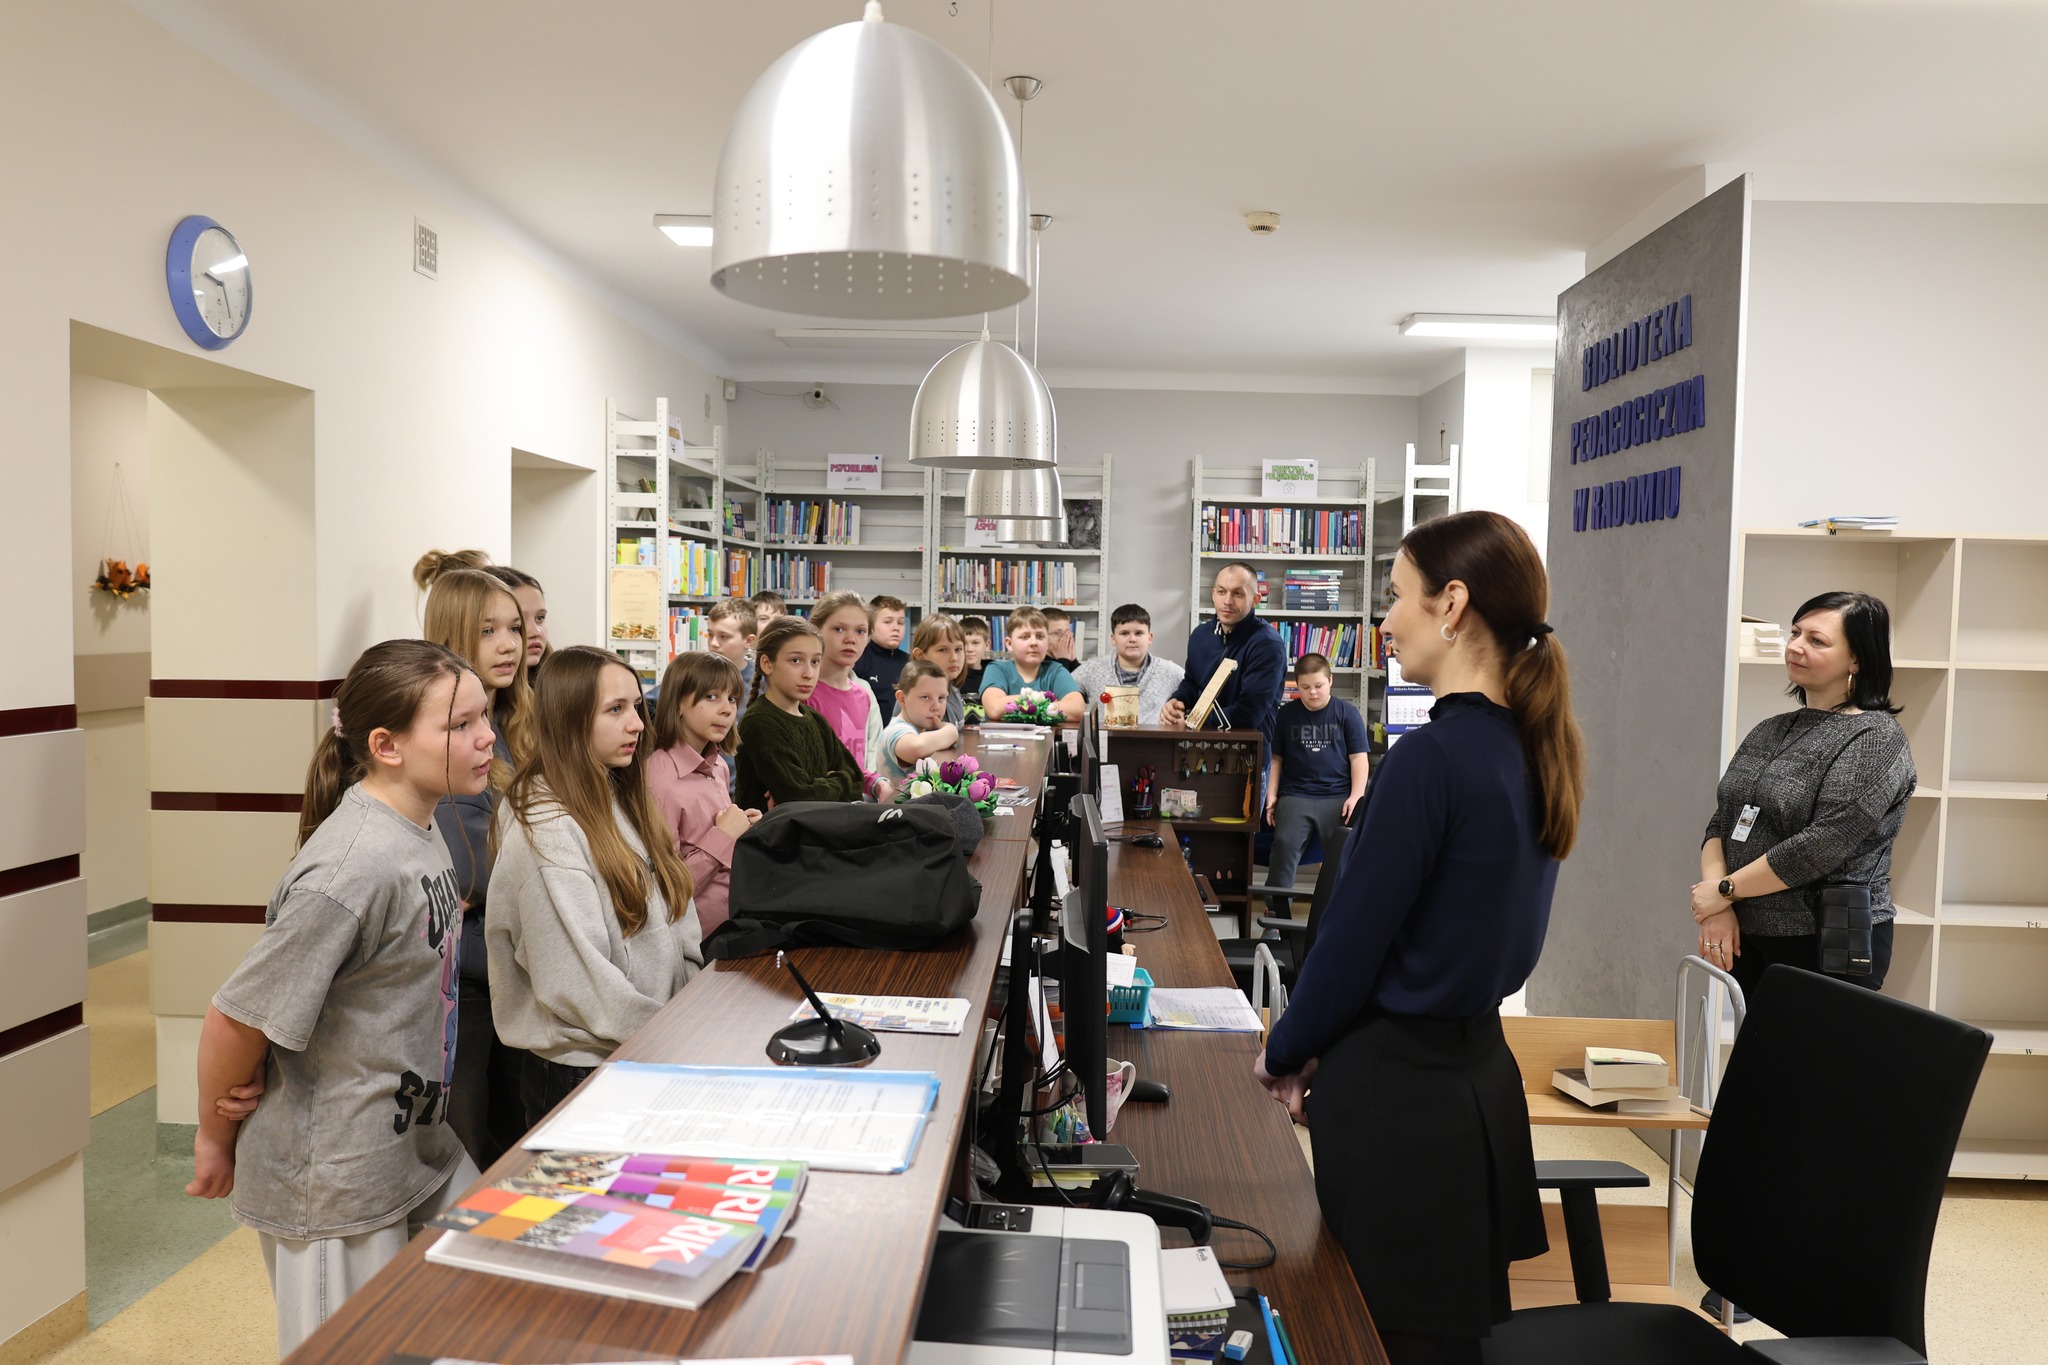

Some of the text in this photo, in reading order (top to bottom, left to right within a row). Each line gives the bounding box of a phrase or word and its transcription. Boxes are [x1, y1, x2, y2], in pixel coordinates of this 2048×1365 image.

[1582, 294, 1692, 391] BIBLIOTEKA
[1570, 374, 1705, 465] PEDAGOGICZNA
[830, 463, 878, 473] PSYCHOLOGIA
[1573, 466, 1681, 532] W RADOMIU
[1290, 722, 1342, 742] DENIM
[394, 1070, 448, 1135] ST
[709, 1189, 772, 1222] RI
[643, 1215, 735, 1264] RIK
